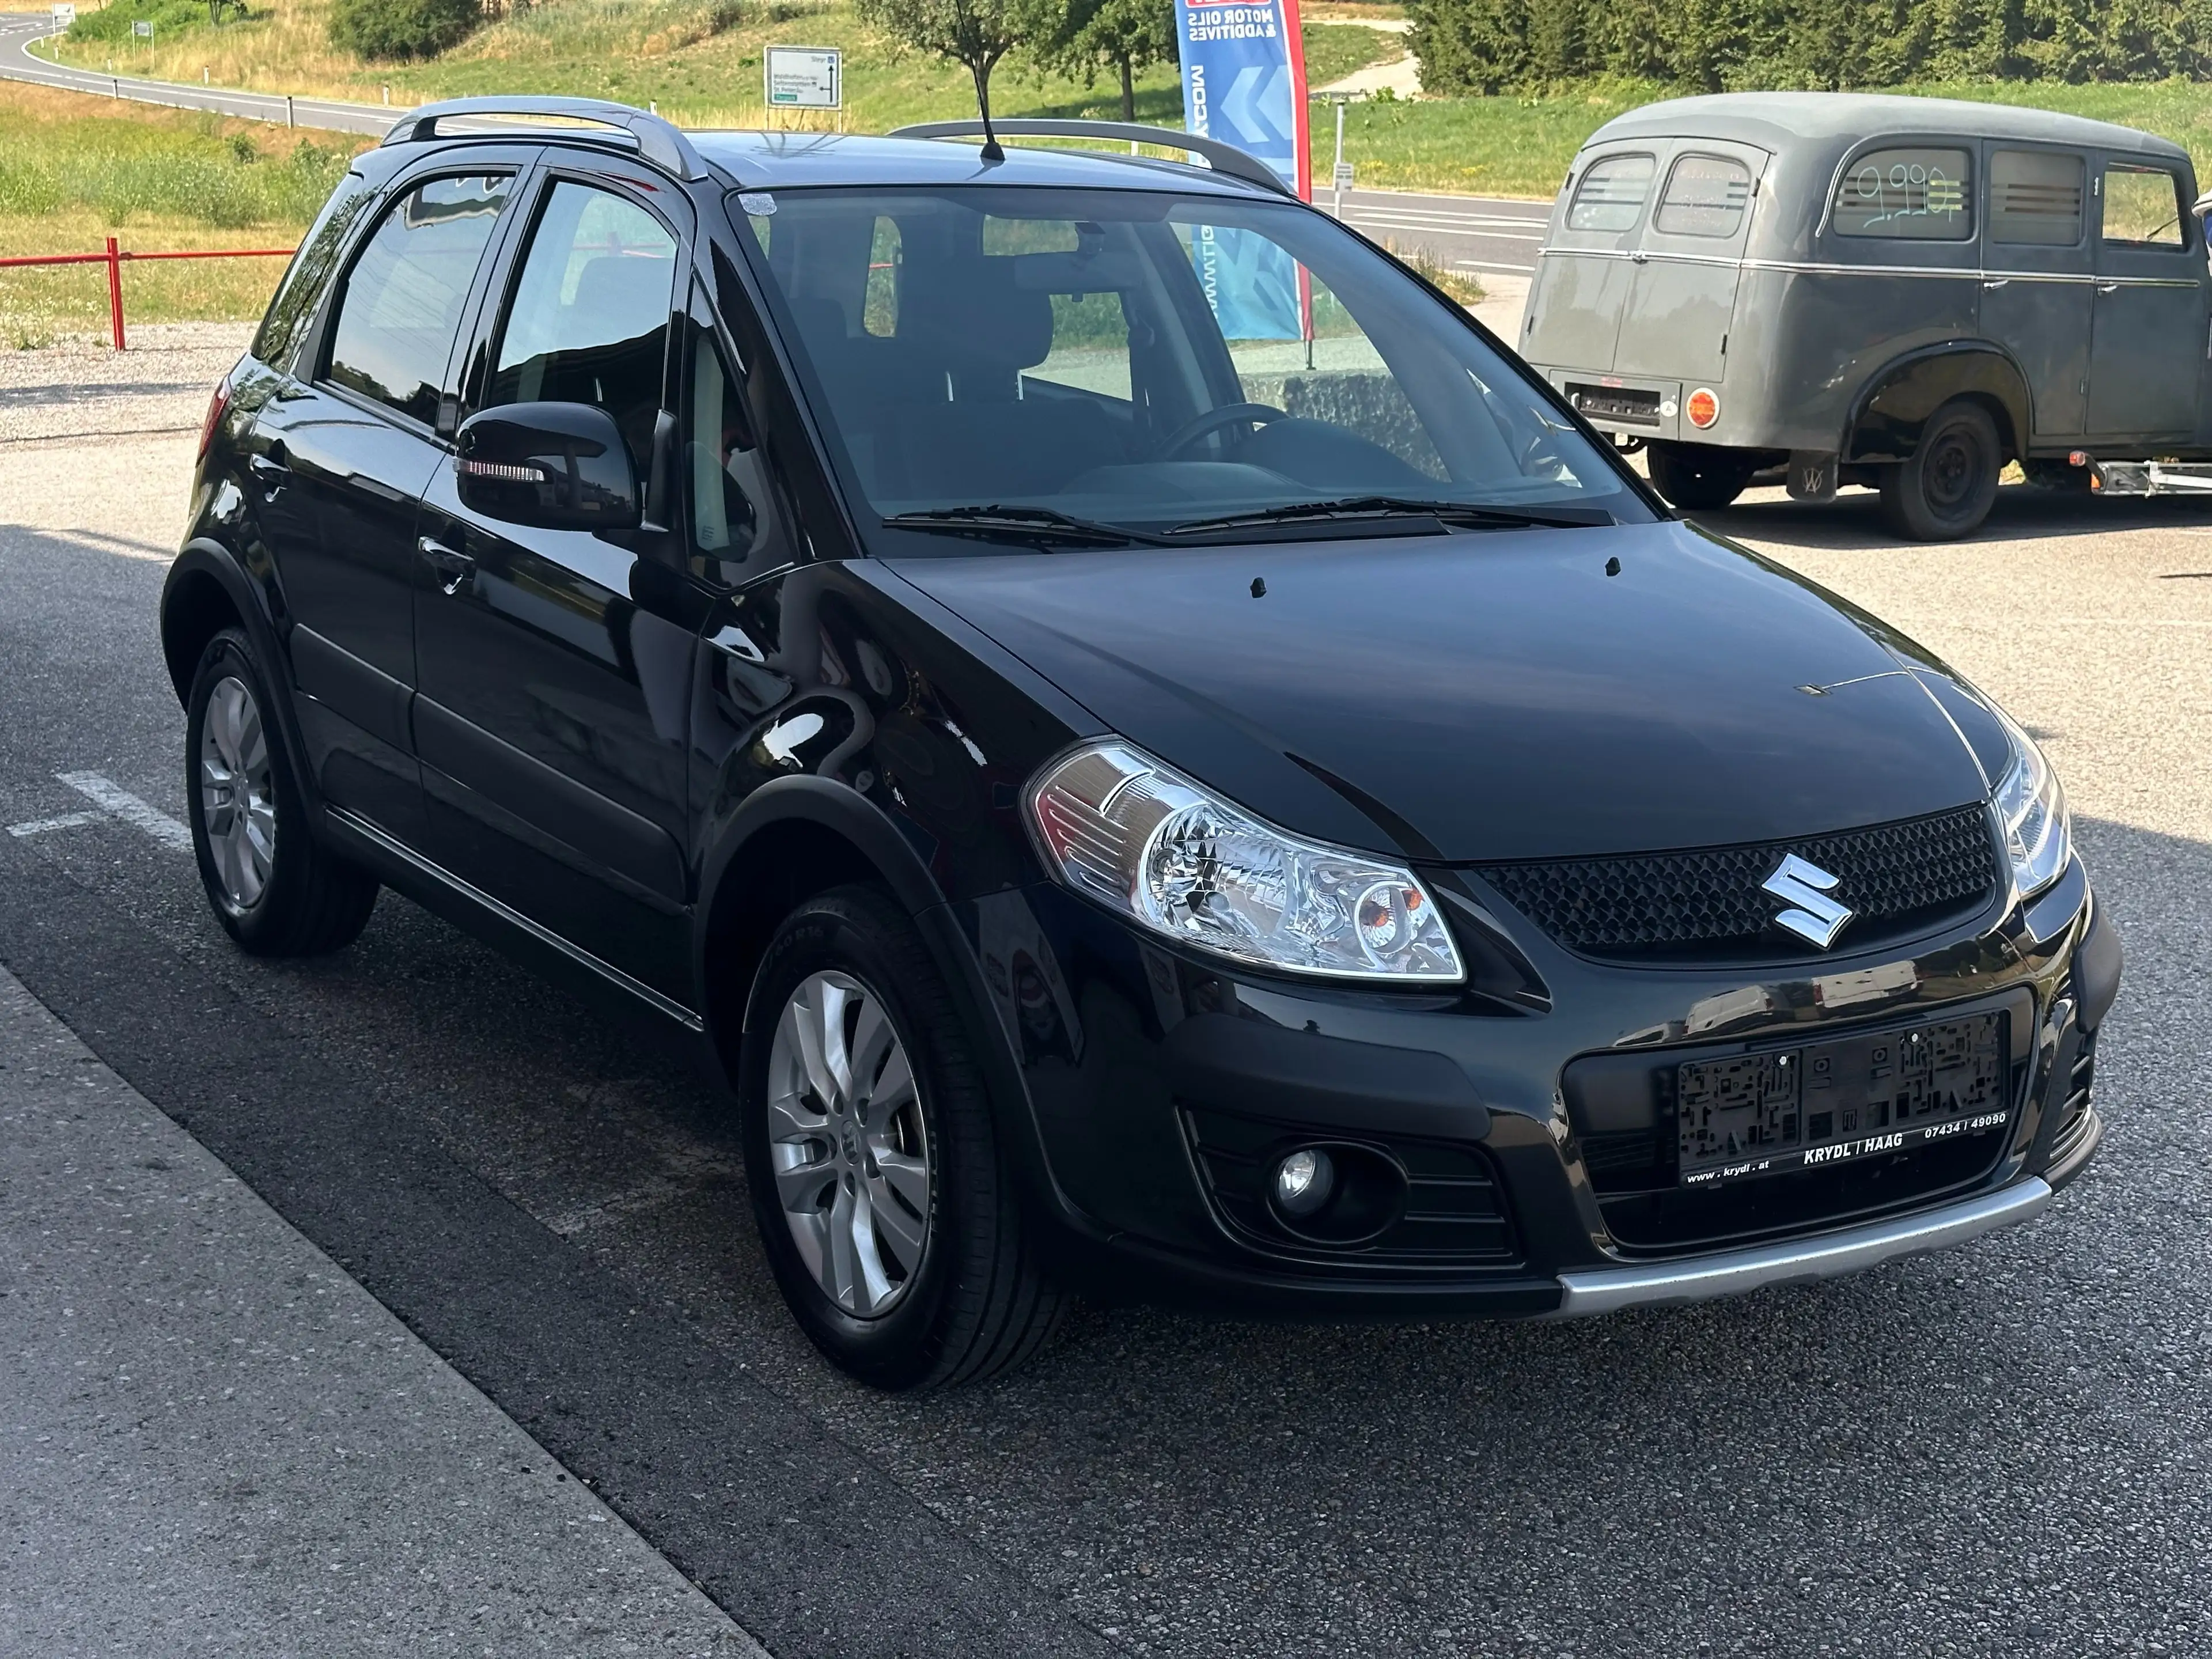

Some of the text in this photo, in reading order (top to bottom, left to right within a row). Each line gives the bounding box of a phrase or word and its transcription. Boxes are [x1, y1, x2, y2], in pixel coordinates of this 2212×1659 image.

[1804, 1143, 1851, 1164] KRYDL
[1864, 1133, 1903, 1152] HAAG
[1925, 1123, 1960, 1138] 07434
[1971, 1113, 2006, 1127] 49090
